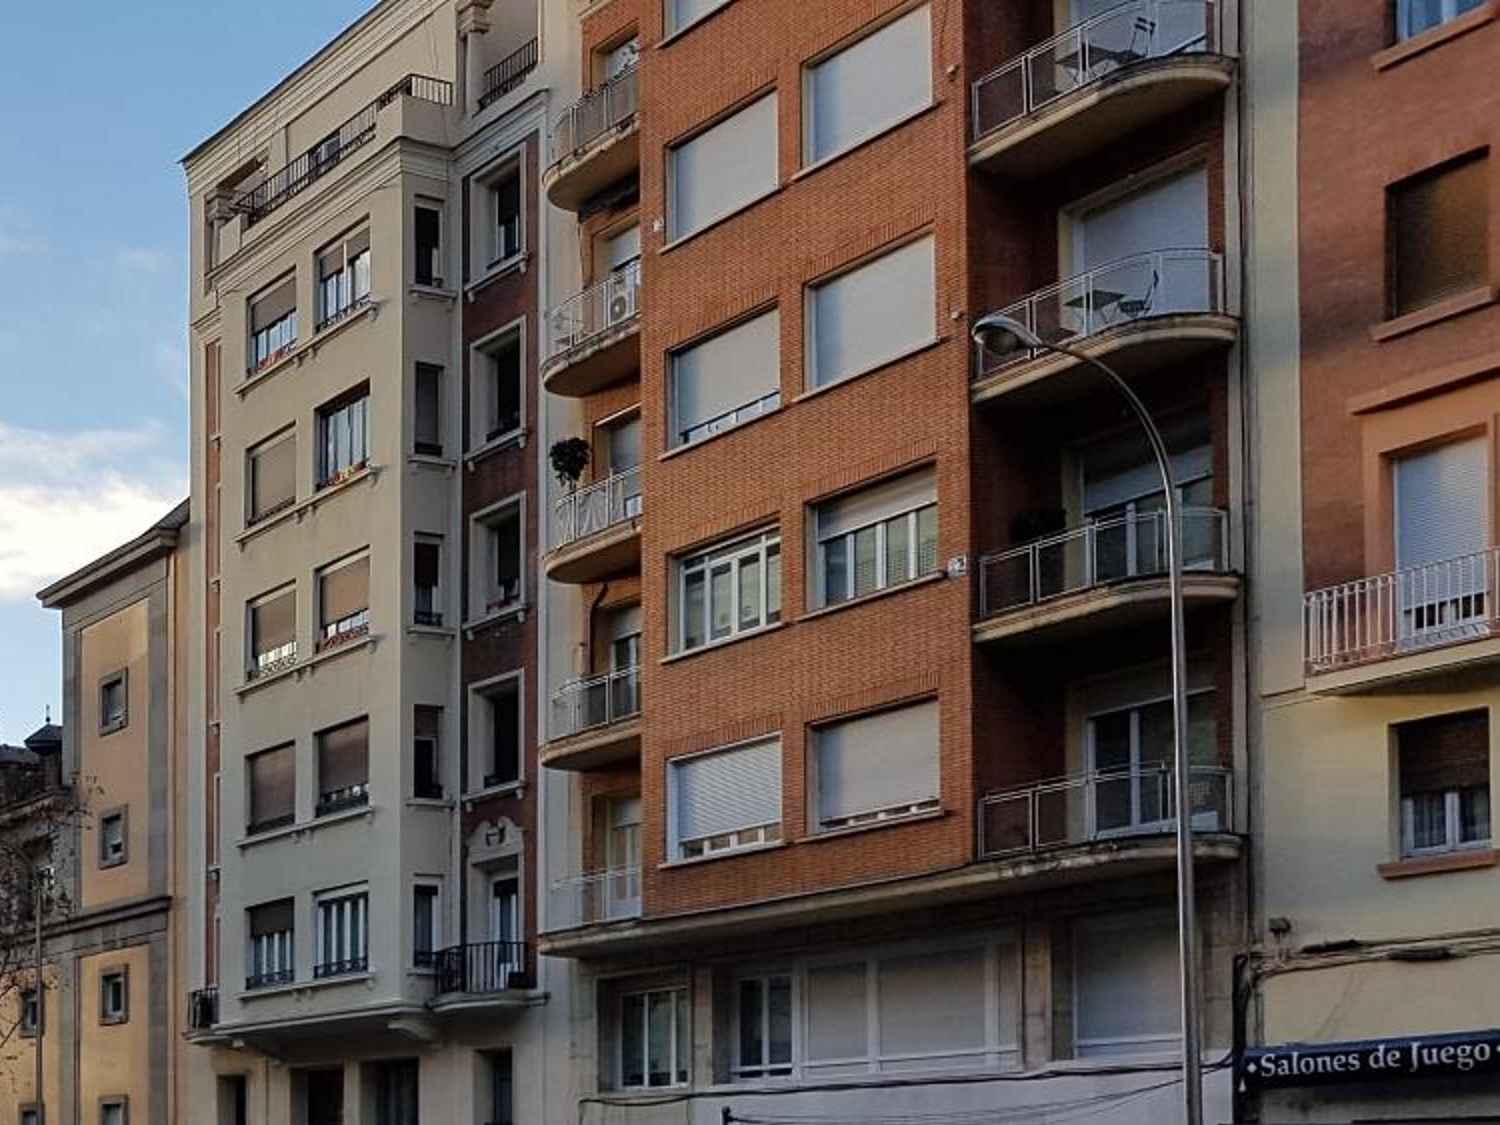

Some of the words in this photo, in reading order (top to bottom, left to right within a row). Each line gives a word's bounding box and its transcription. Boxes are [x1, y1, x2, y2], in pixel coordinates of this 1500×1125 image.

[1261, 1051, 1360, 1077] Salones
[1369, 1044, 1400, 1069] de
[1410, 1041, 1491, 1072] Juego
